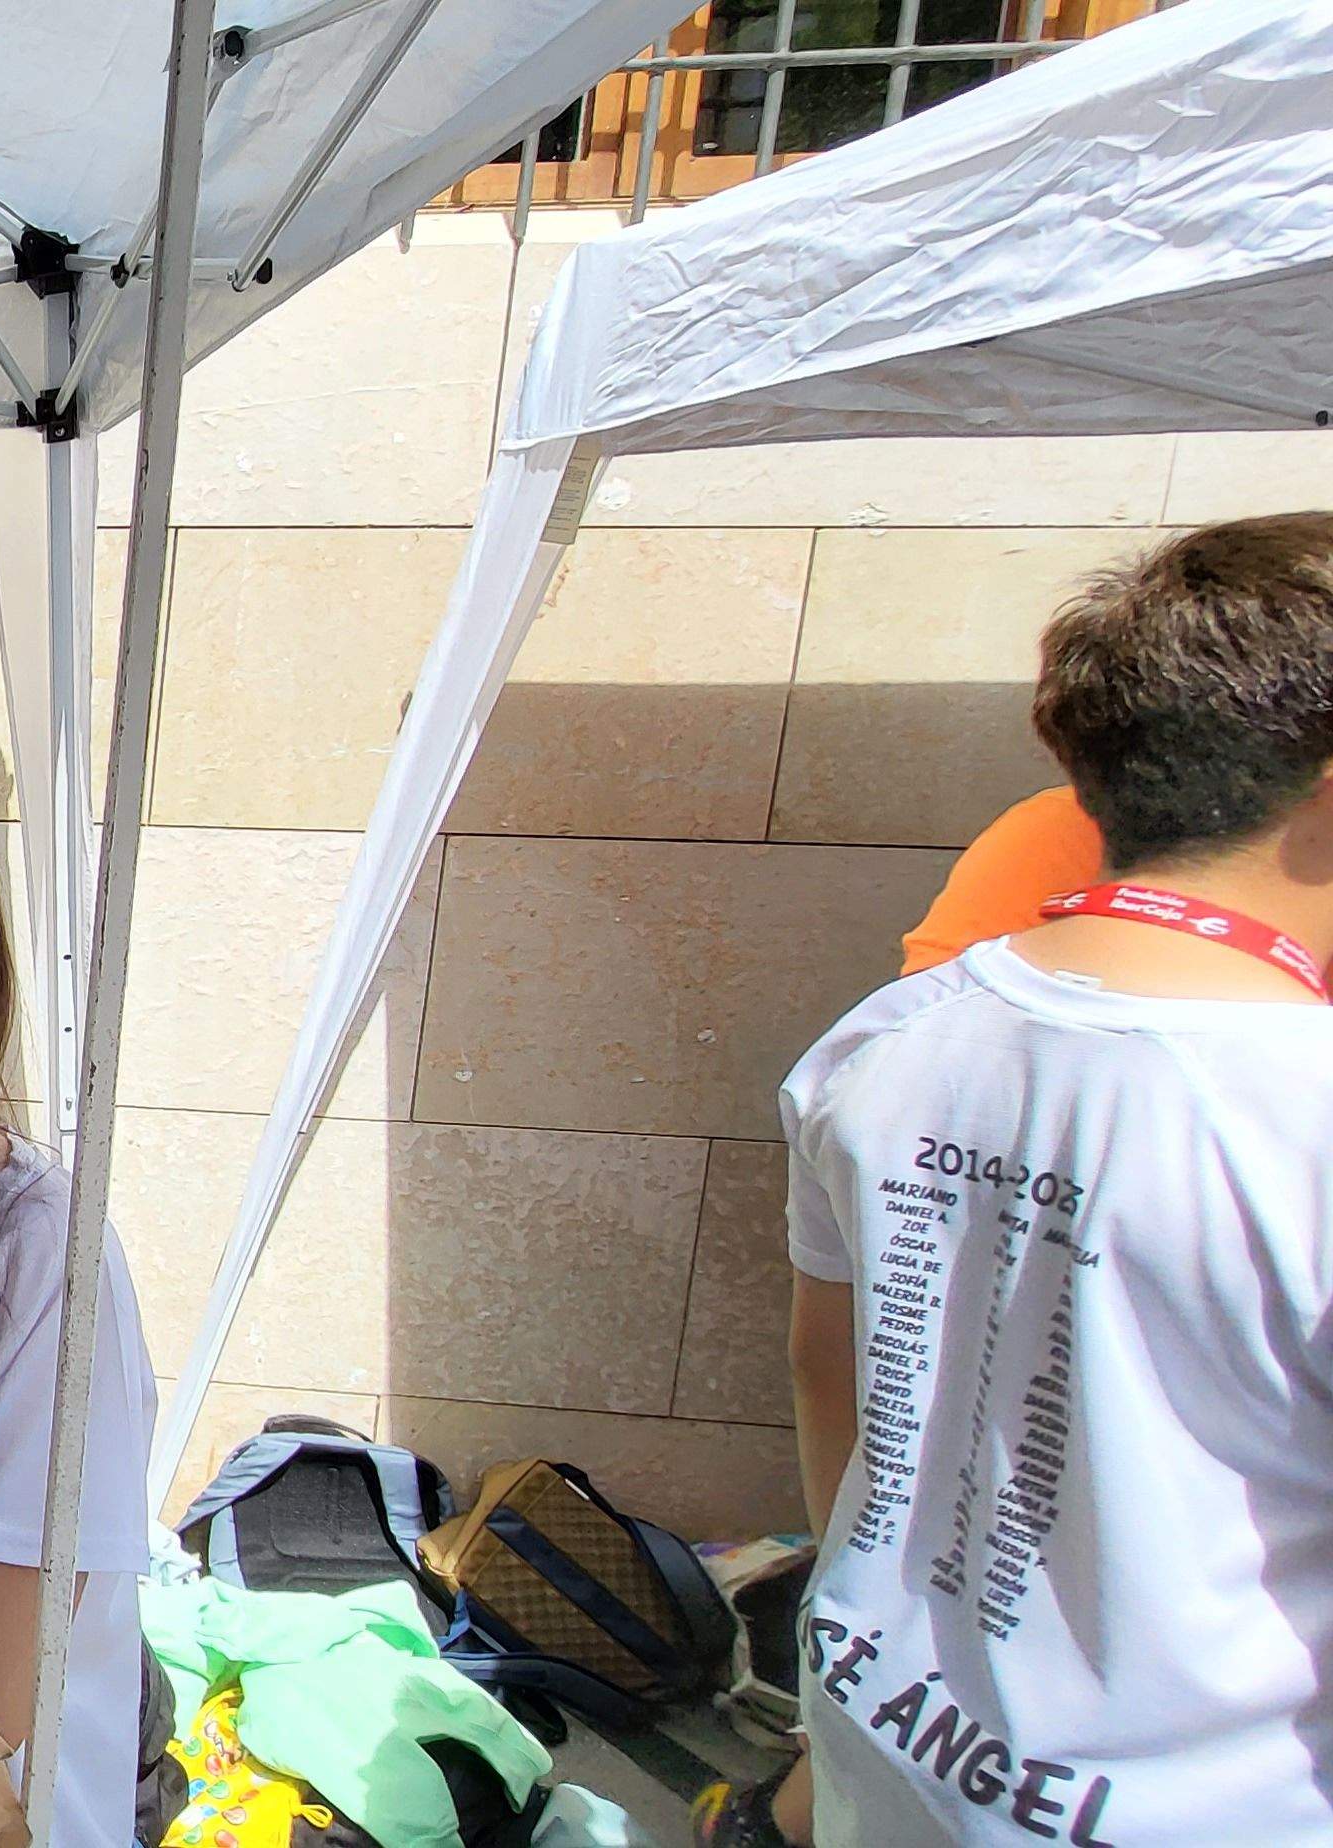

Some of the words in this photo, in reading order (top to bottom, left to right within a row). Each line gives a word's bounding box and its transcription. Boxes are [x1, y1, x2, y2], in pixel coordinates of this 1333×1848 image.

[878, 1178, 958, 1207] MARIANO
[901, 1218, 930, 1234] ZOE
[889, 1233, 937, 1255] ÓSCAR
[879, 1251, 917, 1272] LUCÍA
[888, 1271, 928, 1289] SOFÍA
[873, 1283, 925, 1304] VALERIA
[879, 1315, 925, 1335] PEDRO
[871, 1671, 1116, 1848] ÁNGEL
